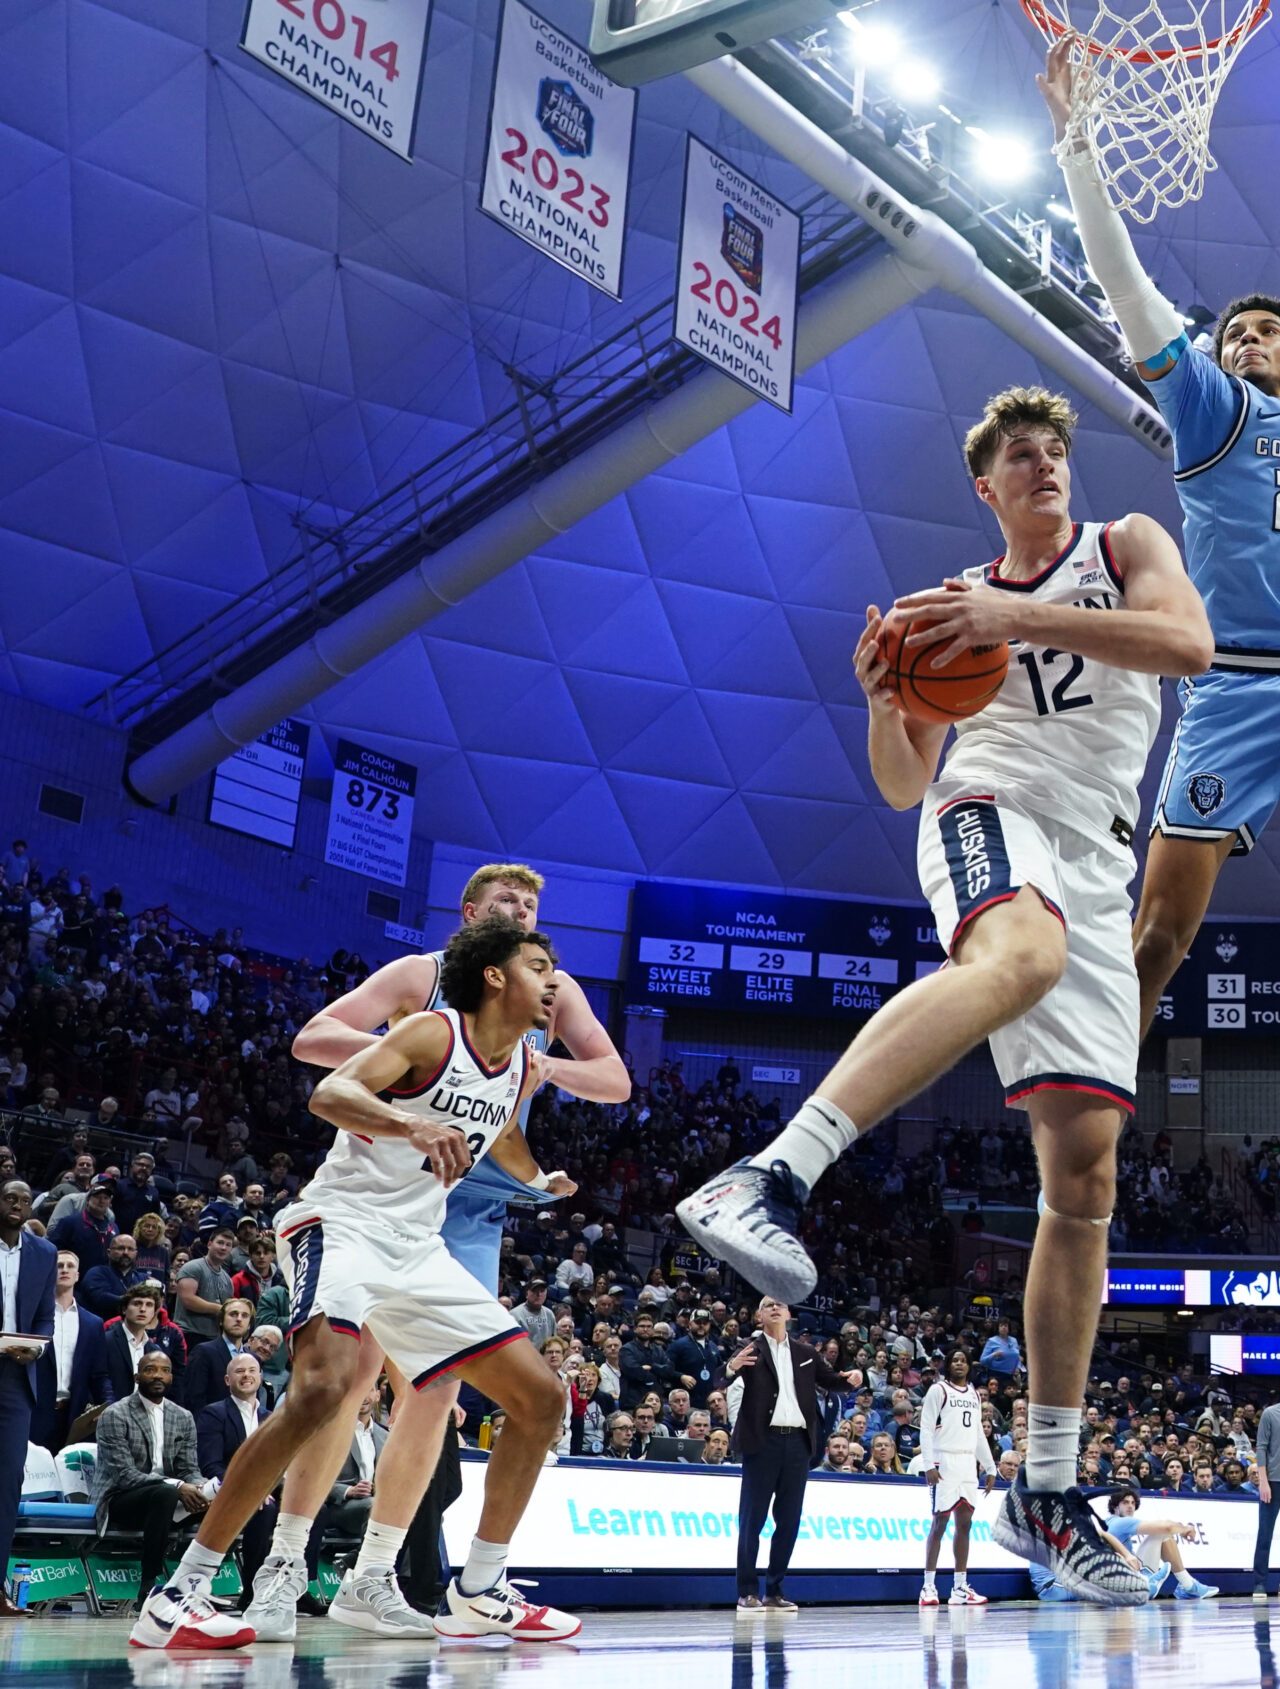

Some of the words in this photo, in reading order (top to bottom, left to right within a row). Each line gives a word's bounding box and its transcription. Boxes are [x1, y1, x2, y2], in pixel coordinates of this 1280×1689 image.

[529, 15, 573, 58] UConn
[278, 19, 389, 109] NATIONAL
[535, 40, 604, 100] Basketball
[264, 41, 394, 139] CHAMPIONS
[549, 90, 586, 128] FINAL
[550, 110, 587, 147] FOUR
[501, 127, 611, 228] 2023
[709, 155, 748, 192] UConn
[750, 187, 782, 217] Men's
[715, 178, 774, 229] Basketball
[509, 178, 600, 252] NATIONAL
[499, 199, 606, 280] CHAMPIONS
[727, 220, 756, 250] FINAL
[727, 232, 755, 263] FOUR
[690, 261, 783, 350] 2024
[697, 308, 774, 372] NATIONAL
[688, 328, 778, 398] CHAMPIONS
[1017, 646, 1094, 717] 12
[360, 751, 396, 773] COACH
[343, 759, 360, 772] JIM
[361, 766, 410, 792] CALHOUN
[346, 779, 401, 820] 873
[340, 816, 364, 831] National
[363, 823, 405, 845] Championships
[356, 834, 371, 846] Final
[371, 839, 387, 852] Fours
[954, 807, 992, 900] HUSKIES
[344, 854, 357, 867] Hall
[363, 861, 379, 875] Fame
[363, 850, 404, 871] Championships
[735, 911, 777, 926] NCAA
[401, 929, 425, 945] 223
[705, 924, 806, 944] TOURNAMENT
[668, 943, 696, 962] 32
[757, 952, 785, 970] 29
[649, 966, 712, 985] SWEET
[844, 959, 872, 977] 24
[647, 981, 712, 997] SIXTEENS
[746, 974, 794, 991] ELITE
[832, 982, 882, 998] FINAL
[1216, 978, 1238, 995] 31
[745, 989, 793, 1004] EIGHTS
[832, 996, 881, 1010] FOURS
[1212, 1007, 1241, 1025] 30
[753, 1070, 770, 1079] SEC
[780, 1070, 796, 1082] 12
[1170, 1081, 1199, 1090] NORTH
[429, 1088, 512, 1127] UCONN
[675, 1255, 692, 1266] SEC
[1108, 1283, 1132, 1291] MAKE
[1134, 1283, 1157, 1291] SOME
[1159, 1284, 1185, 1292] NOISE
[1242, 1352, 1268, 1361] MAKE
[962, 1410, 972, 1428] 0
[567, 1498, 668, 1538] Learn
[45, 1562, 80, 1581] Bank
[96, 1568, 129, 1583] M&T
